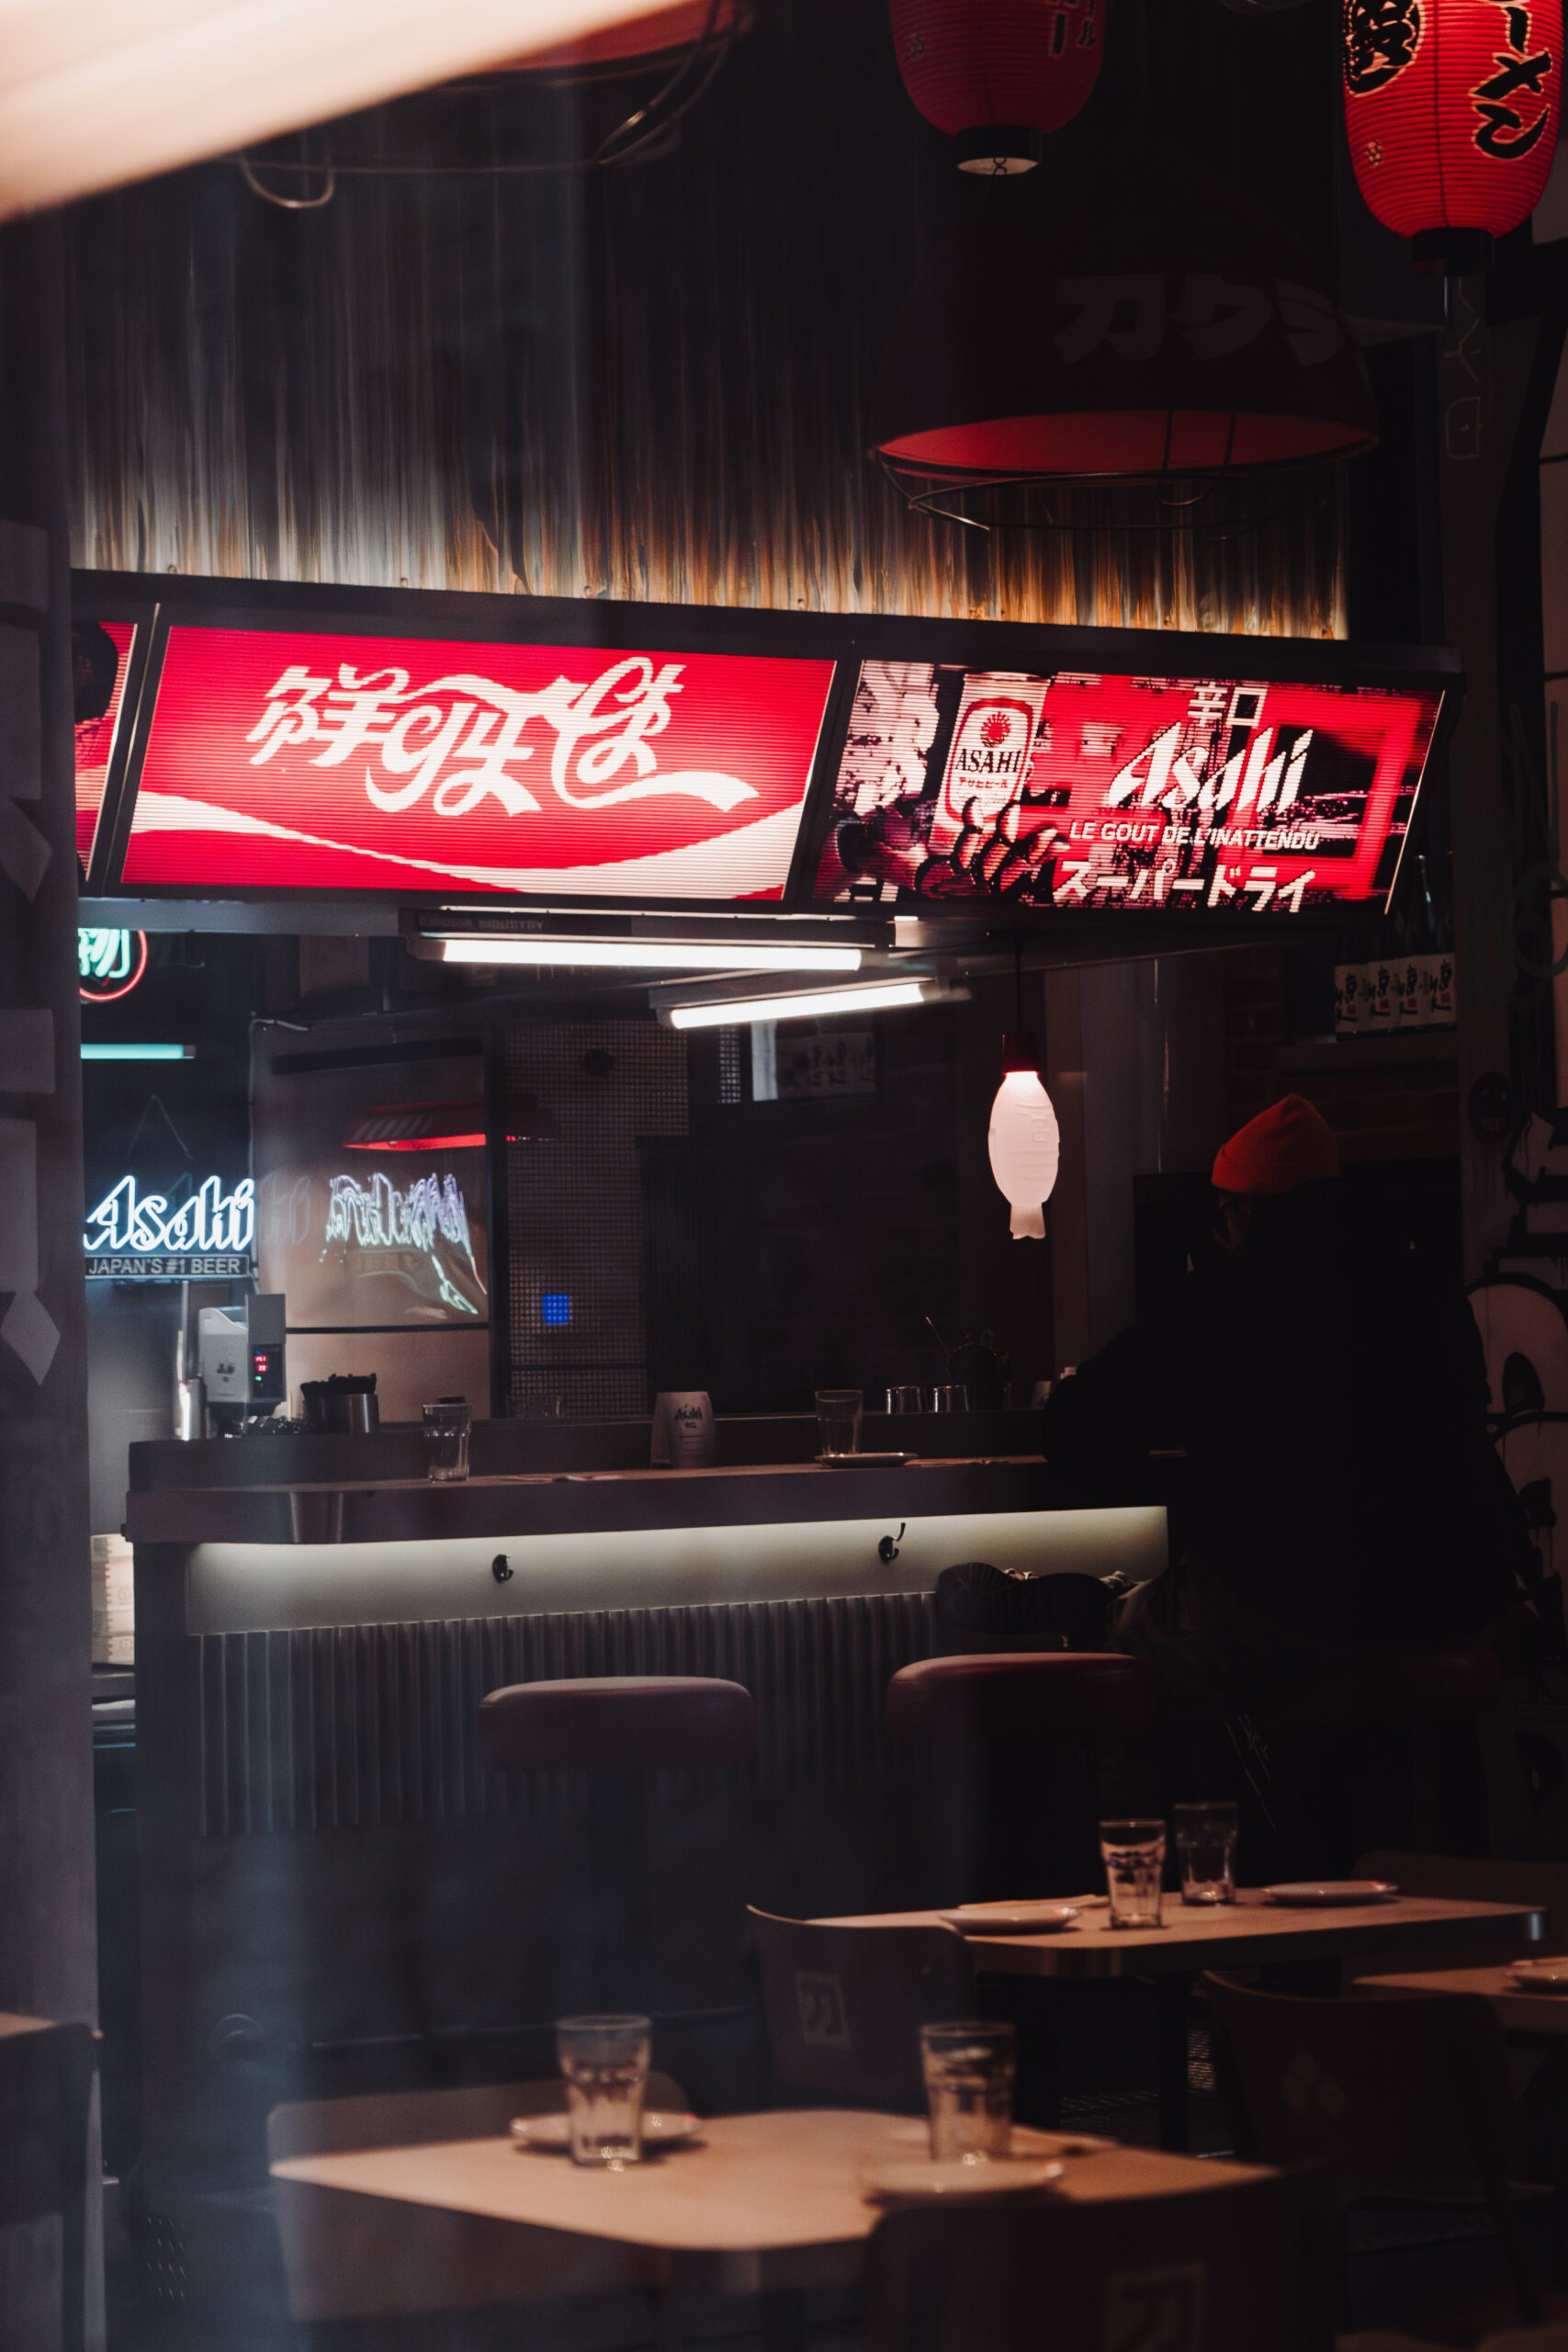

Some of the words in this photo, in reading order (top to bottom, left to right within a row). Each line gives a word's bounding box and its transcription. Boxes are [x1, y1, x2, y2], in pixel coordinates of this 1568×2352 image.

[1188, 681, 1268, 729] 辛口
[955, 748, 1021, 773] ASAHI
[1106, 719, 1314, 815] Asahi
[1069, 821, 1092, 840] LE
[1100, 822, 1160, 842] GOUT
[1161, 825, 1191, 845] DE
[1196, 828, 1321, 851] L'INATTENDU
[1052, 856, 1316, 913] スーパードライ
[83, 1174, 255, 1252] Asahi
[88, 1257, 163, 1275] JAPAN'S
[190, 1258, 242, 1274] BEER
